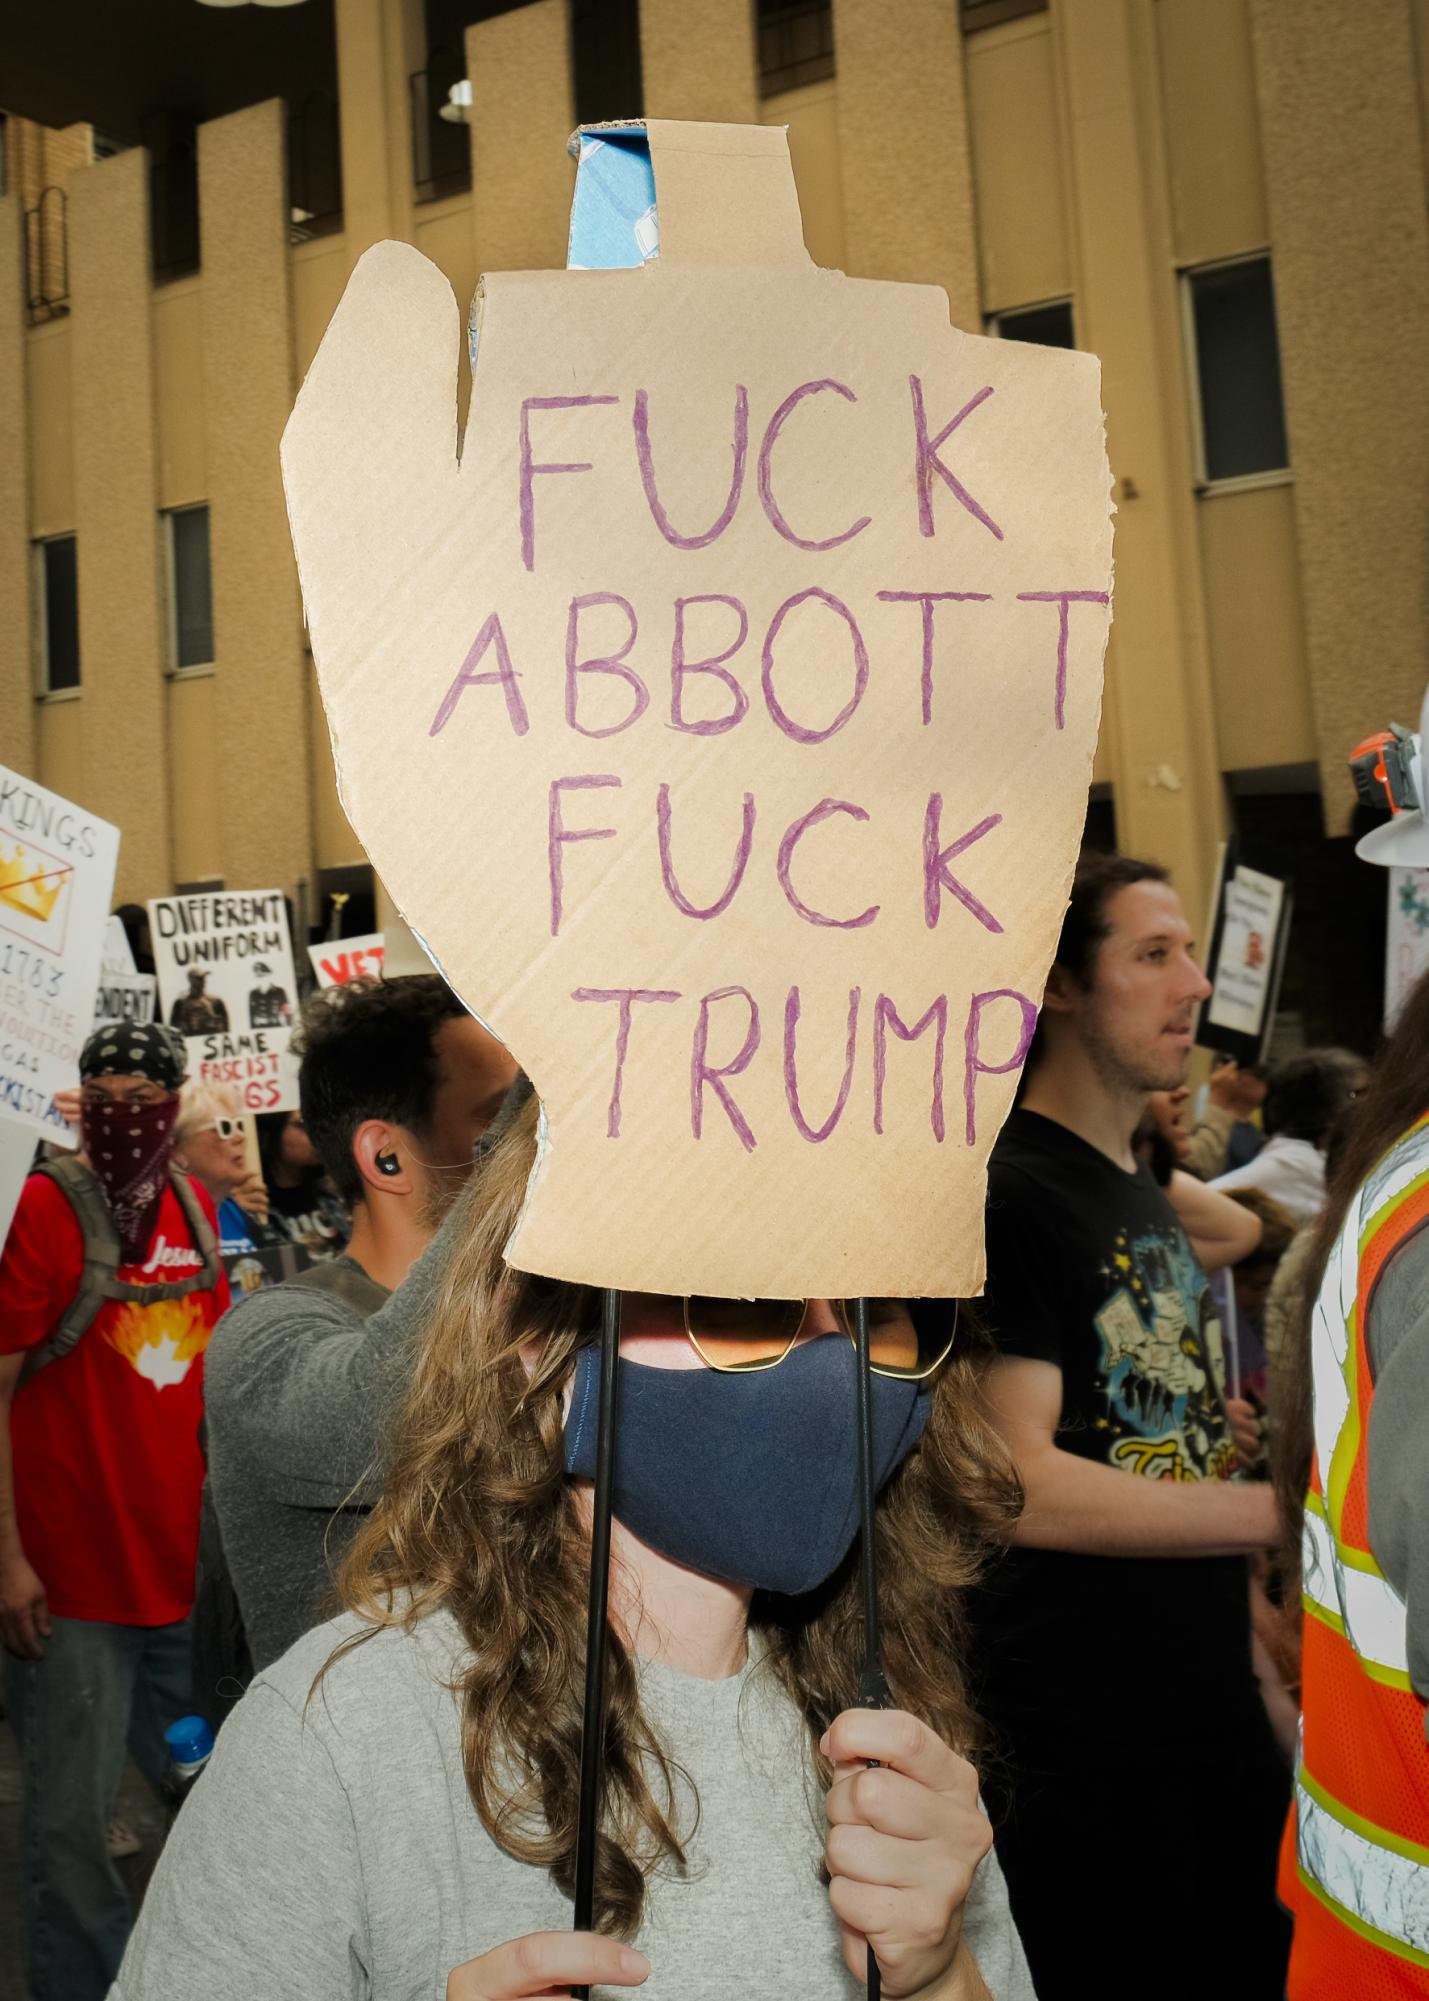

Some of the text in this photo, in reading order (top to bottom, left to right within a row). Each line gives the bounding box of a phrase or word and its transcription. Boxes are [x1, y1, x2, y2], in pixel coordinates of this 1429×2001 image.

[519, 374, 1004, 572] FUCK
[428, 586, 1110, 744] ABBOTT
[0, 779, 97, 859] KINGS
[548, 774, 1005, 937] FUCK
[156, 895, 282, 938] DIFFERENT
[1, 944, 66, 998] 1783
[173, 932, 283, 966] UNIFORM
[200, 1054, 281, 1084] FASCIST
[204, 1033, 269, 1061] SAME
[570, 984, 1038, 1153] TRUMP
[242, 1081, 282, 1109] GS
